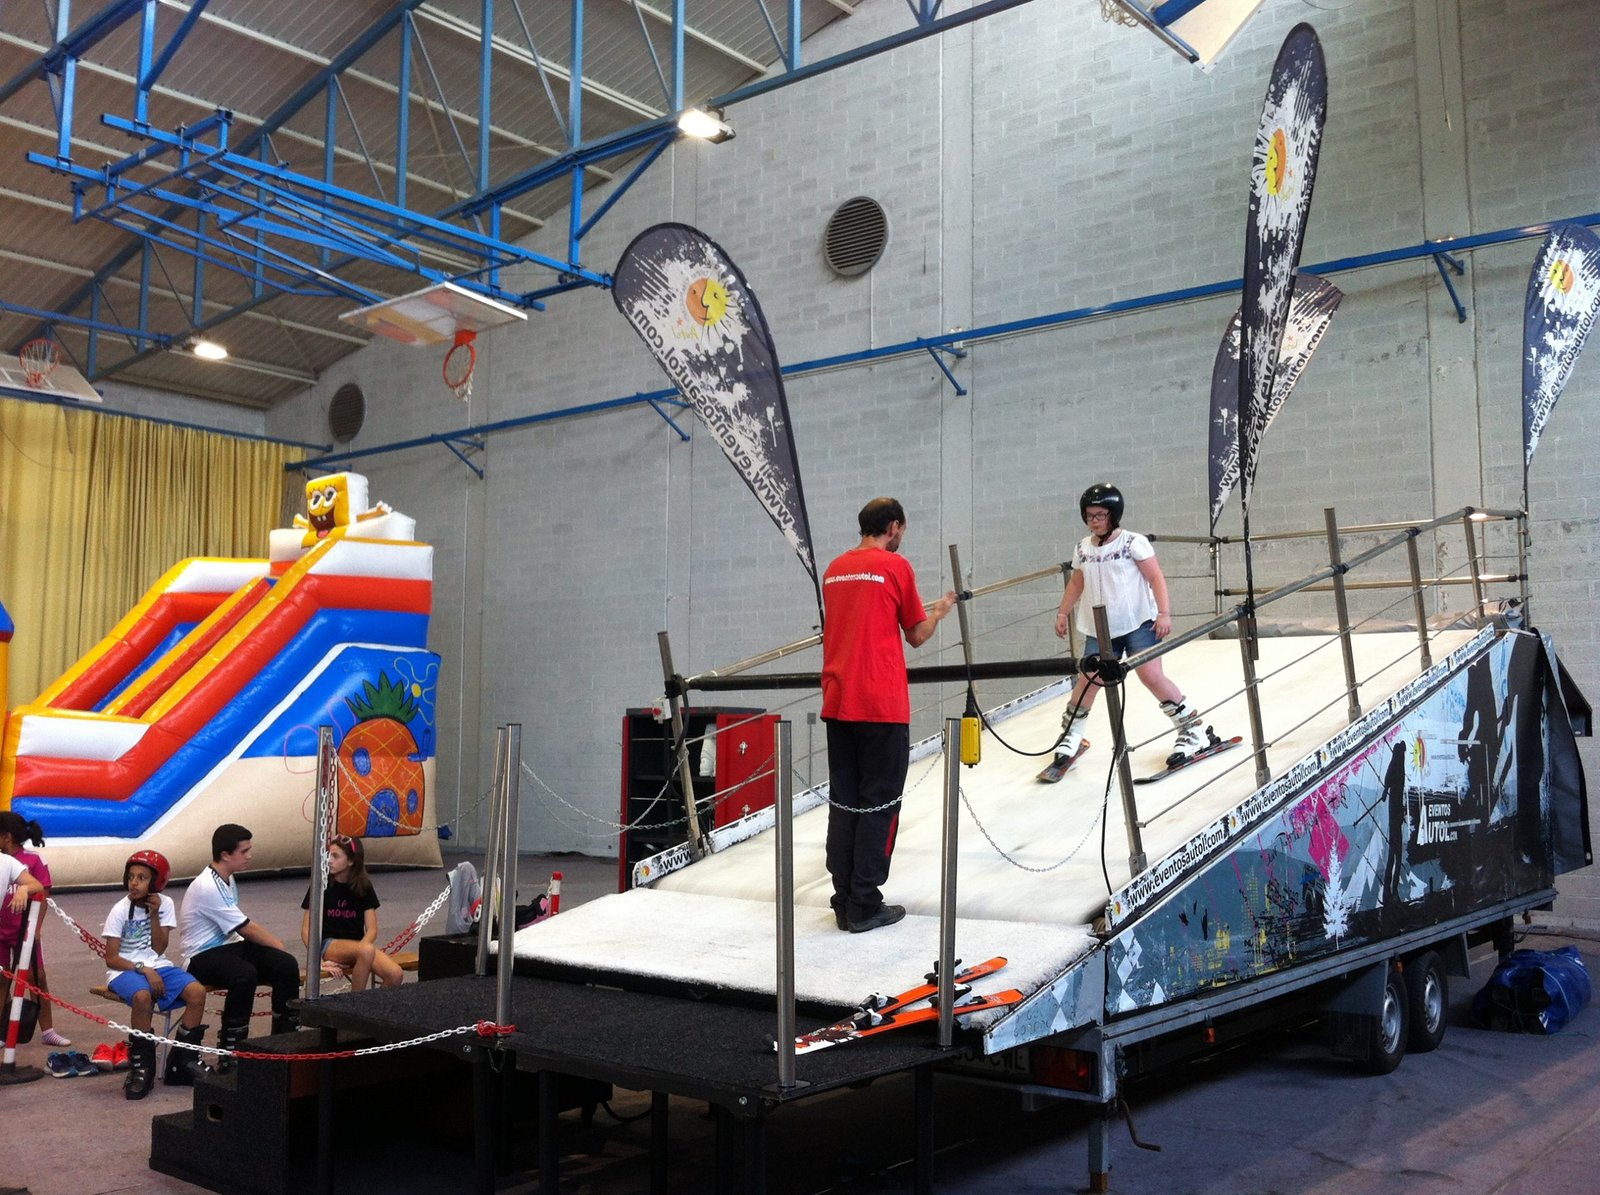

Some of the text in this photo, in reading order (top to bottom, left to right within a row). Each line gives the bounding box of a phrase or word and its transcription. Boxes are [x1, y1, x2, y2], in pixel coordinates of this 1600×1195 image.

[1243, 761, 1318, 822] www.eventosautol.com
[1428, 803, 1451, 817] EVENTOS
[1130, 829, 1224, 906] www.eventosautol.com
